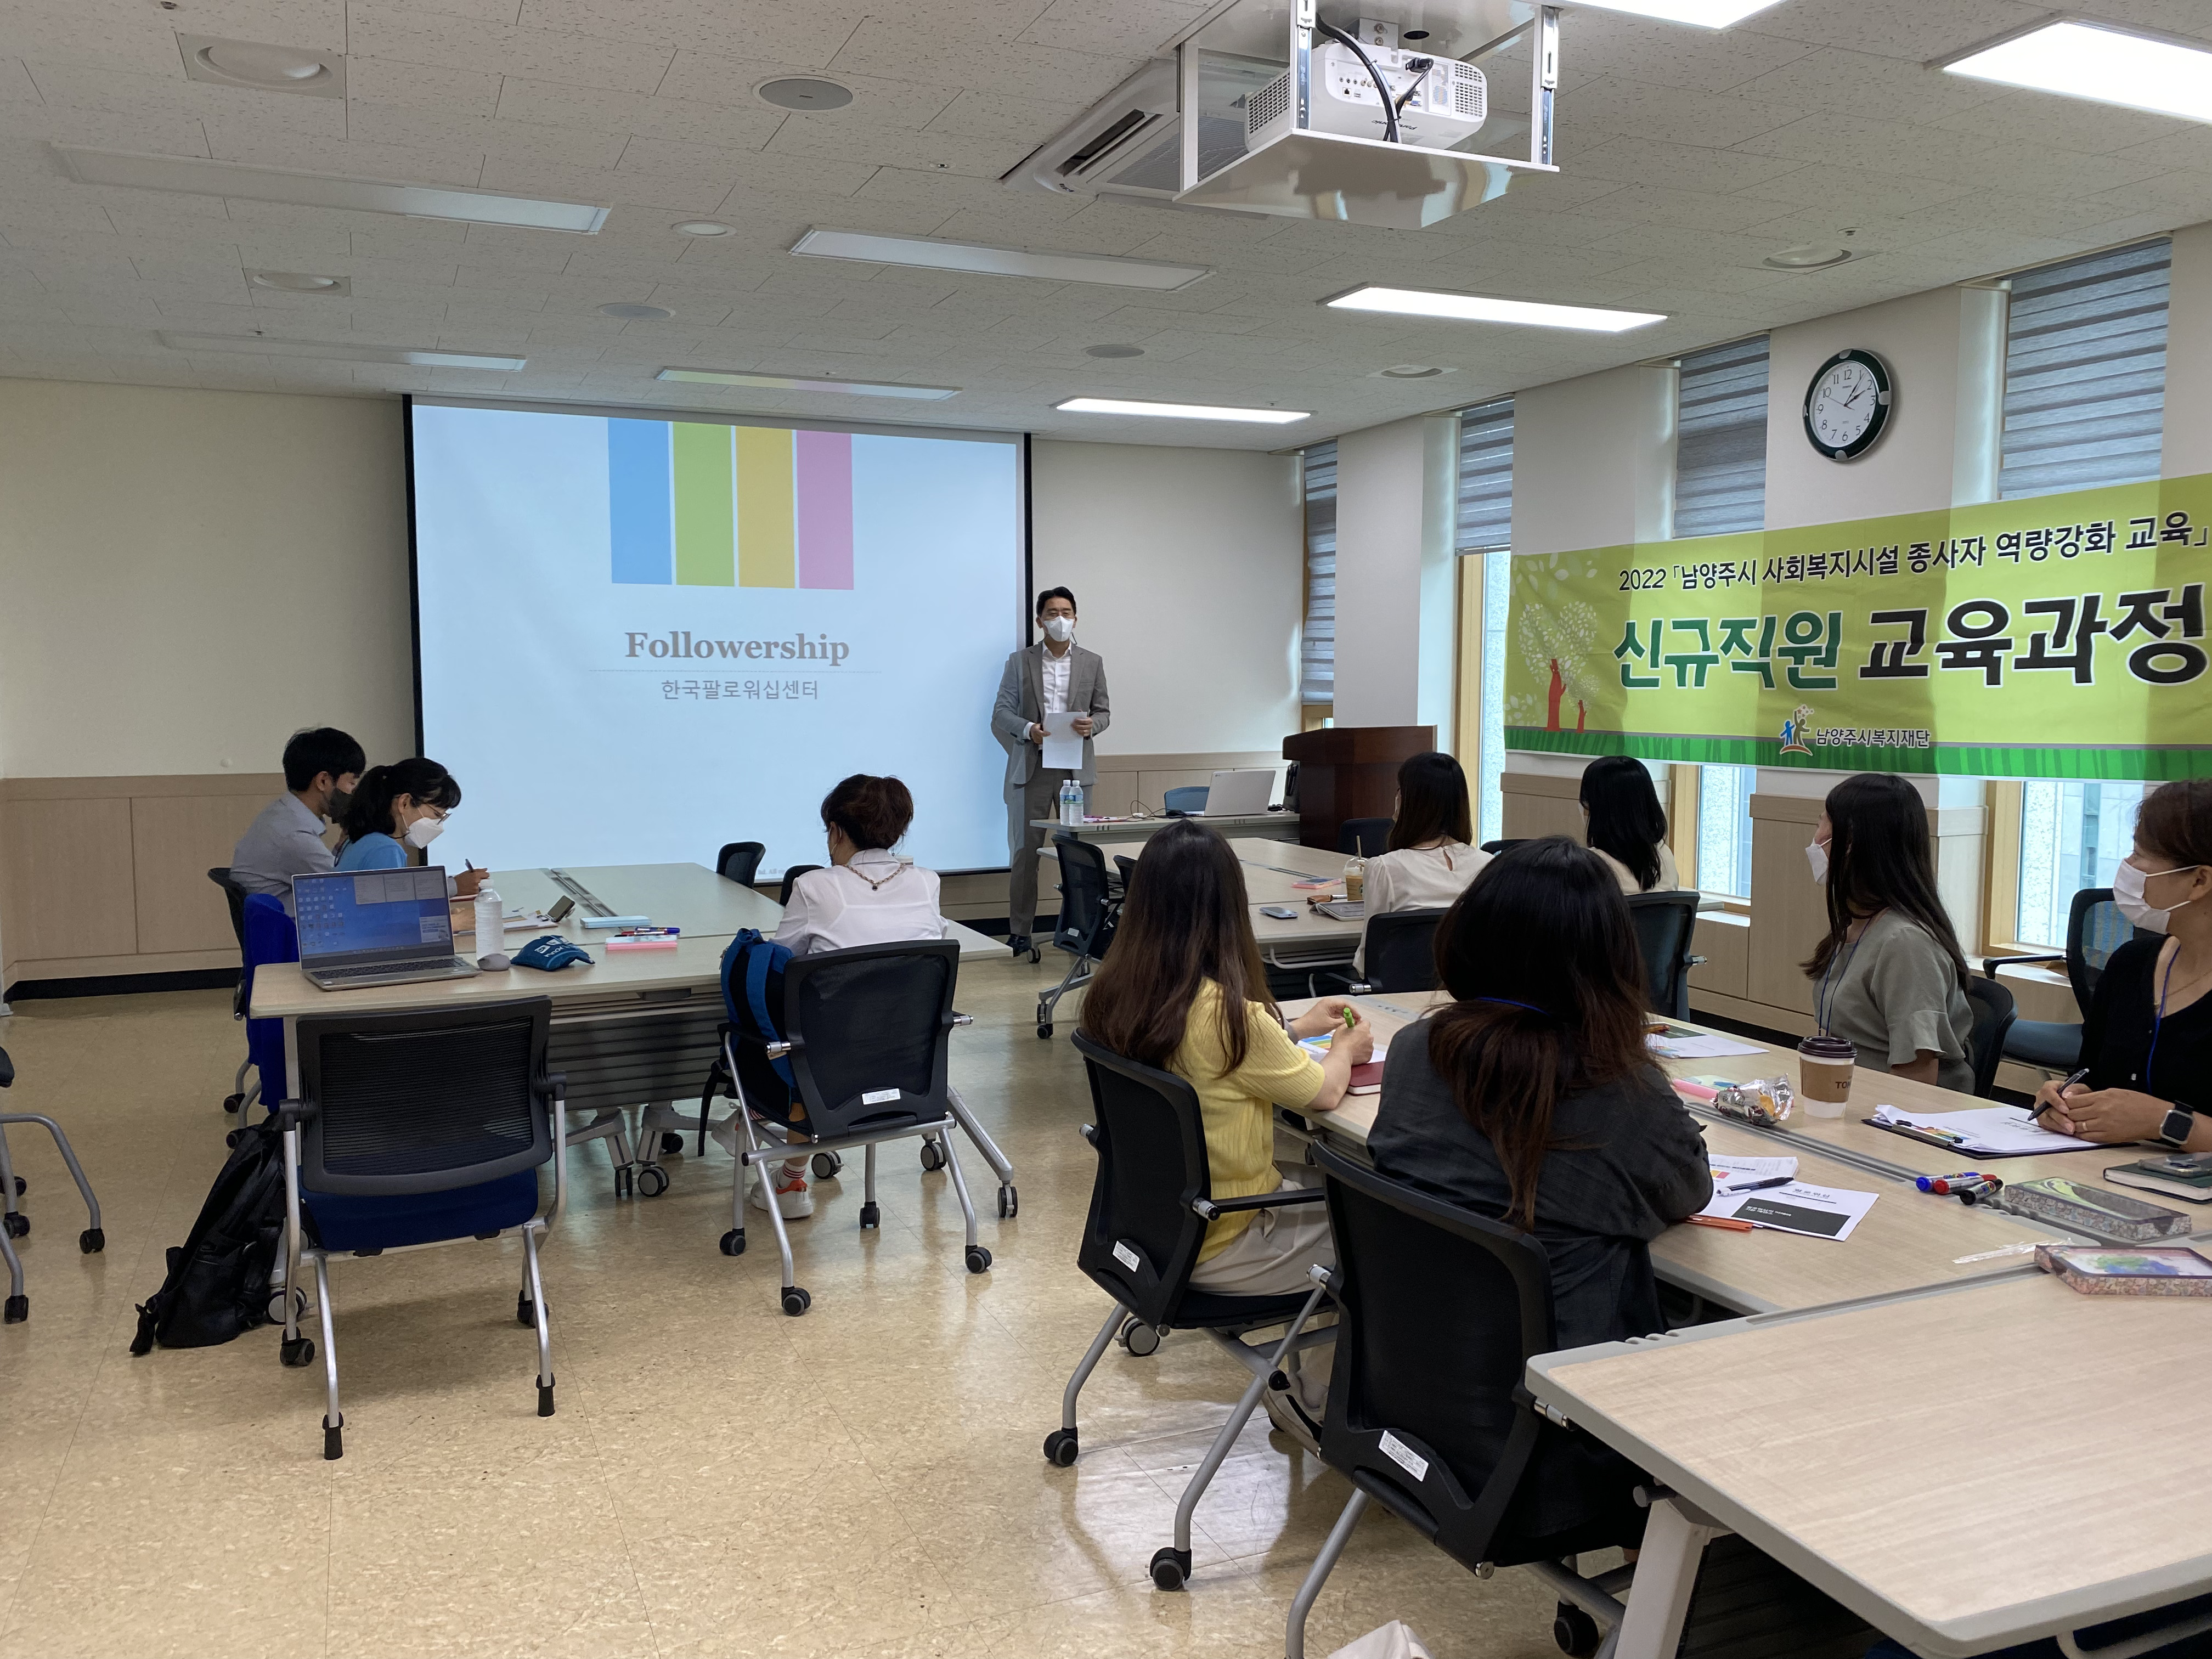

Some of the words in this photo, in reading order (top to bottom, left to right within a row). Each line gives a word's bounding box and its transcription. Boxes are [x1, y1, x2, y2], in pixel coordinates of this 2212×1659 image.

[1833, 374, 1839, 384] 11
[1844, 369, 1852, 380] 12
[1866, 379, 1873, 390] 2
[1822, 387, 1831, 398] 10
[1870, 395, 1876, 405] 3
[1818, 404, 1824, 414] 9
[1864, 413, 1870, 422] 4
[1821, 419, 1827, 430] 8
[1831, 429, 1837, 439] 7
[1842, 431, 1848, 441] 6
[1855, 425, 1861, 436] 5
[1619, 568, 1666, 591] 2022
[1762, 545, 1899, 583] 사회복지시설
[1906, 535, 1986, 573] 종사자
[1996, 520, 2116, 563] 역량강화
[1613, 611, 1842, 690] 신규직원
[1859, 584, 2208, 686] 교육과정
[624, 630, 849, 666] Followership
[661, 680, 819, 700] 한국팔로워십센터
[1816, 728, 1931, 747] 남양주시복지재단
